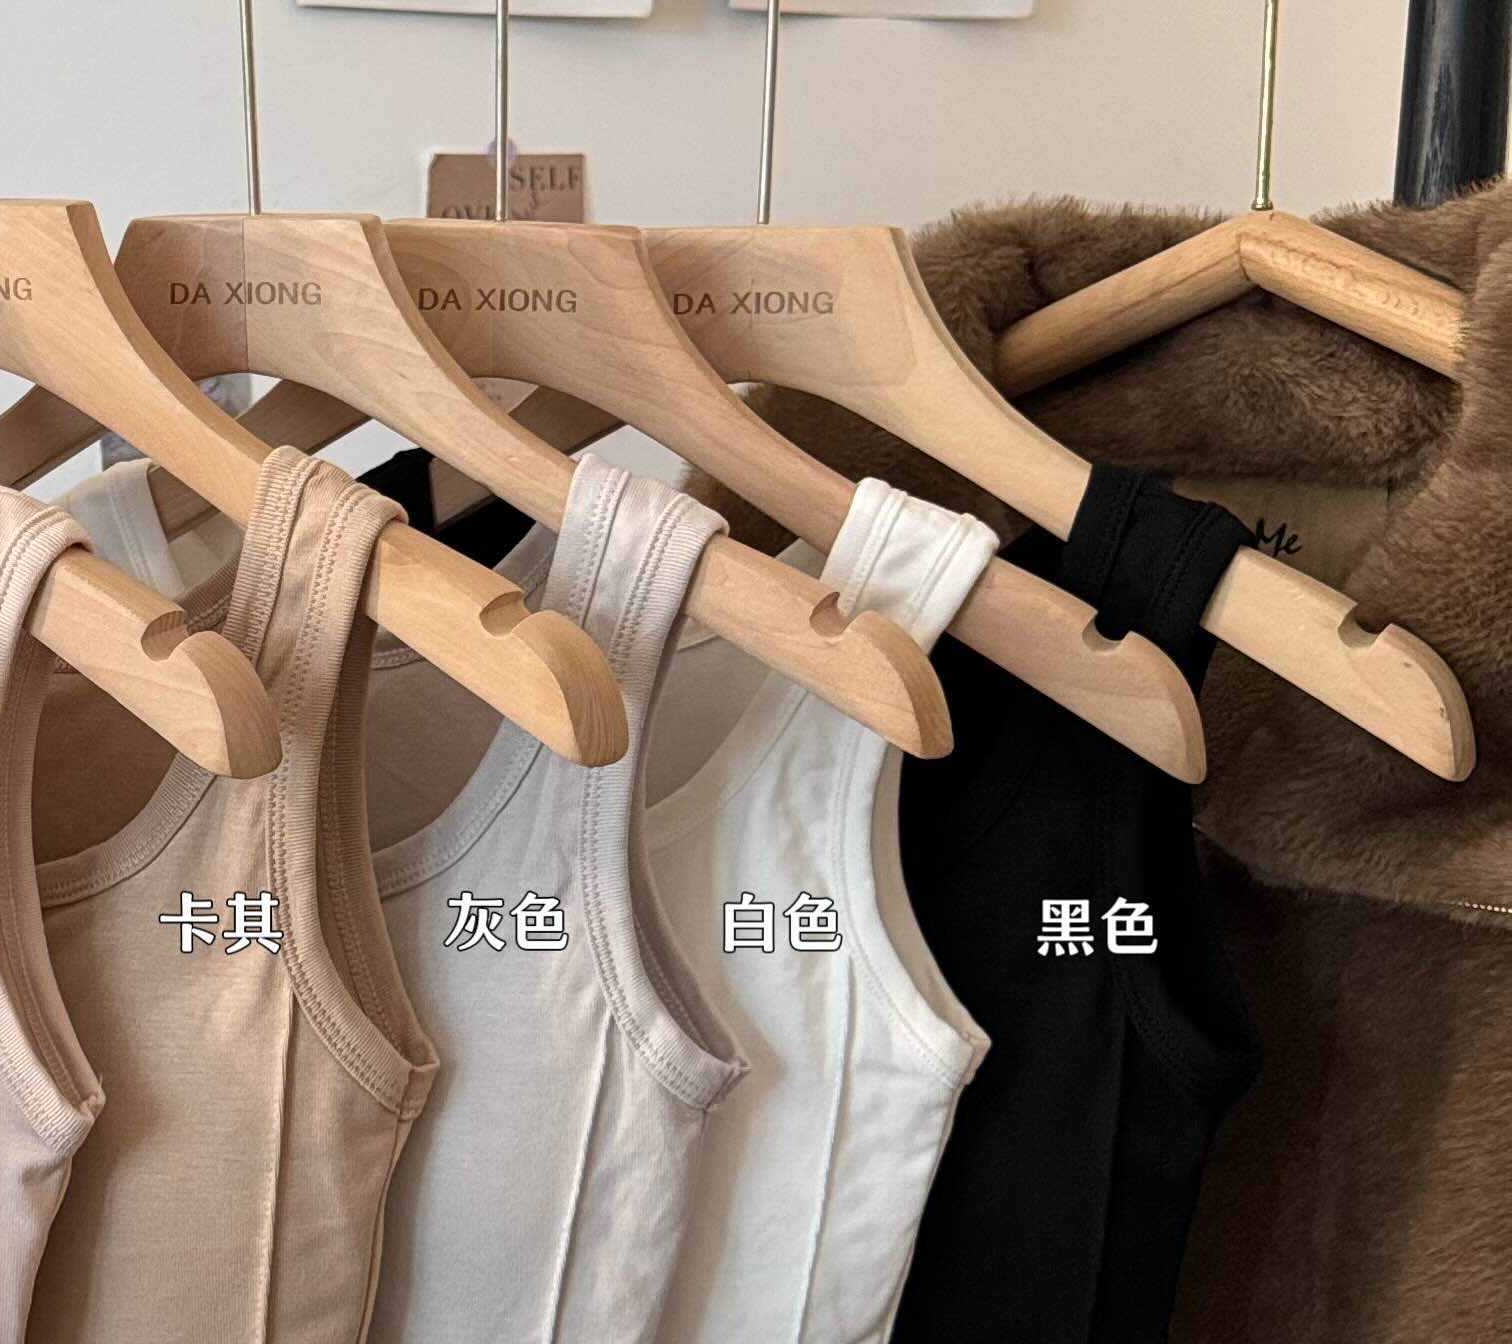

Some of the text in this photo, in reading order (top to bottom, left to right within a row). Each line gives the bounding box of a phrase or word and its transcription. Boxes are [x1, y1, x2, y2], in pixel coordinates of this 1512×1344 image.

[171, 282, 322, 305] DA XIONG
[419, 288, 577, 312] DA XIONG
[674, 292, 834, 316] DA XIONG
